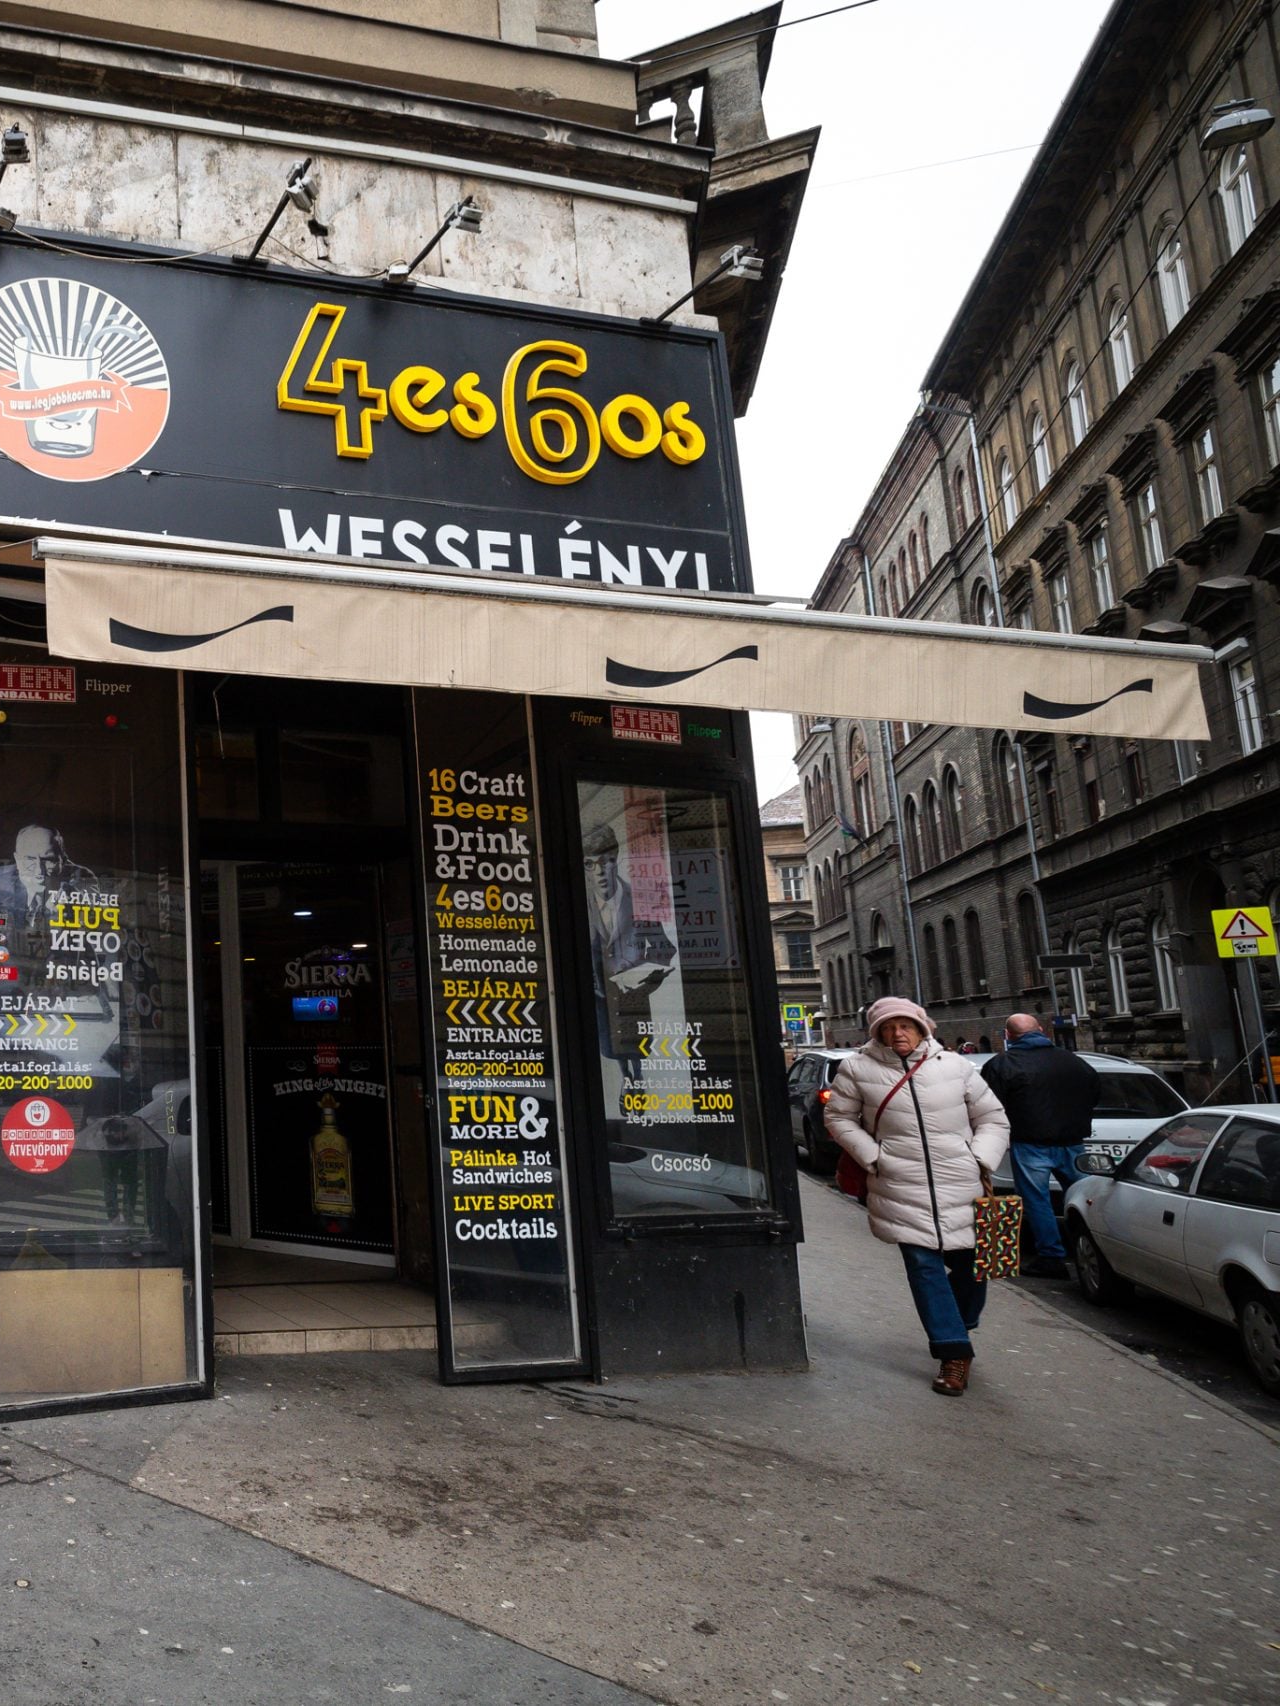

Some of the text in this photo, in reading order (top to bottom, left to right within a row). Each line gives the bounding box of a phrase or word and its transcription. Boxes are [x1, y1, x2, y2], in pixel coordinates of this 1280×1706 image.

[277, 302, 707, 486] 4es6os
[83, 678, 133, 696] Flipper
[569, 710, 605, 727] Flipper
[614, 707, 680, 733] STERN
[687, 723, 722, 740] Flipper
[428, 767, 526, 797] 16 Craft
[429, 794, 530, 823] Beers
[432, 823, 531, 855] Drink
[435, 853, 533, 883] &Food
[434, 883, 535, 913] 4es6os
[434, 911, 537, 934] Wesselényi
[438, 933, 538, 953] Homemade
[283, 957, 372, 989] SIERRA
[439, 953, 539, 974] Lemonade
[443, 976, 539, 1000] BEJÁRAT
[446, 1026, 544, 1044] ENTRANCE
[445, 1048, 545, 1063] Asztalfoglalás:
[639, 1058, 707, 1071] ENTRANCE
[444, 1062, 545, 1078] 0620-200-1000
[272, 1077, 314, 1097] KING
[333, 1077, 388, 1100] NIGHT
[623, 1093, 734, 1111] 0620-200-1000
[447, 1095, 550, 1141] FUN &
[449, 1124, 519, 1141] MORE
[8, 1141, 70, 1157] ÁTVEVŐPONT
[449, 1149, 553, 1168] Pálinka Hot
[651, 1152, 713, 1173] Csocsó
[451, 1167, 554, 1185] Sandwiches
[452, 1193, 556, 1213] LIVE SPORT
[455, 1216, 559, 1242] Cocktails
